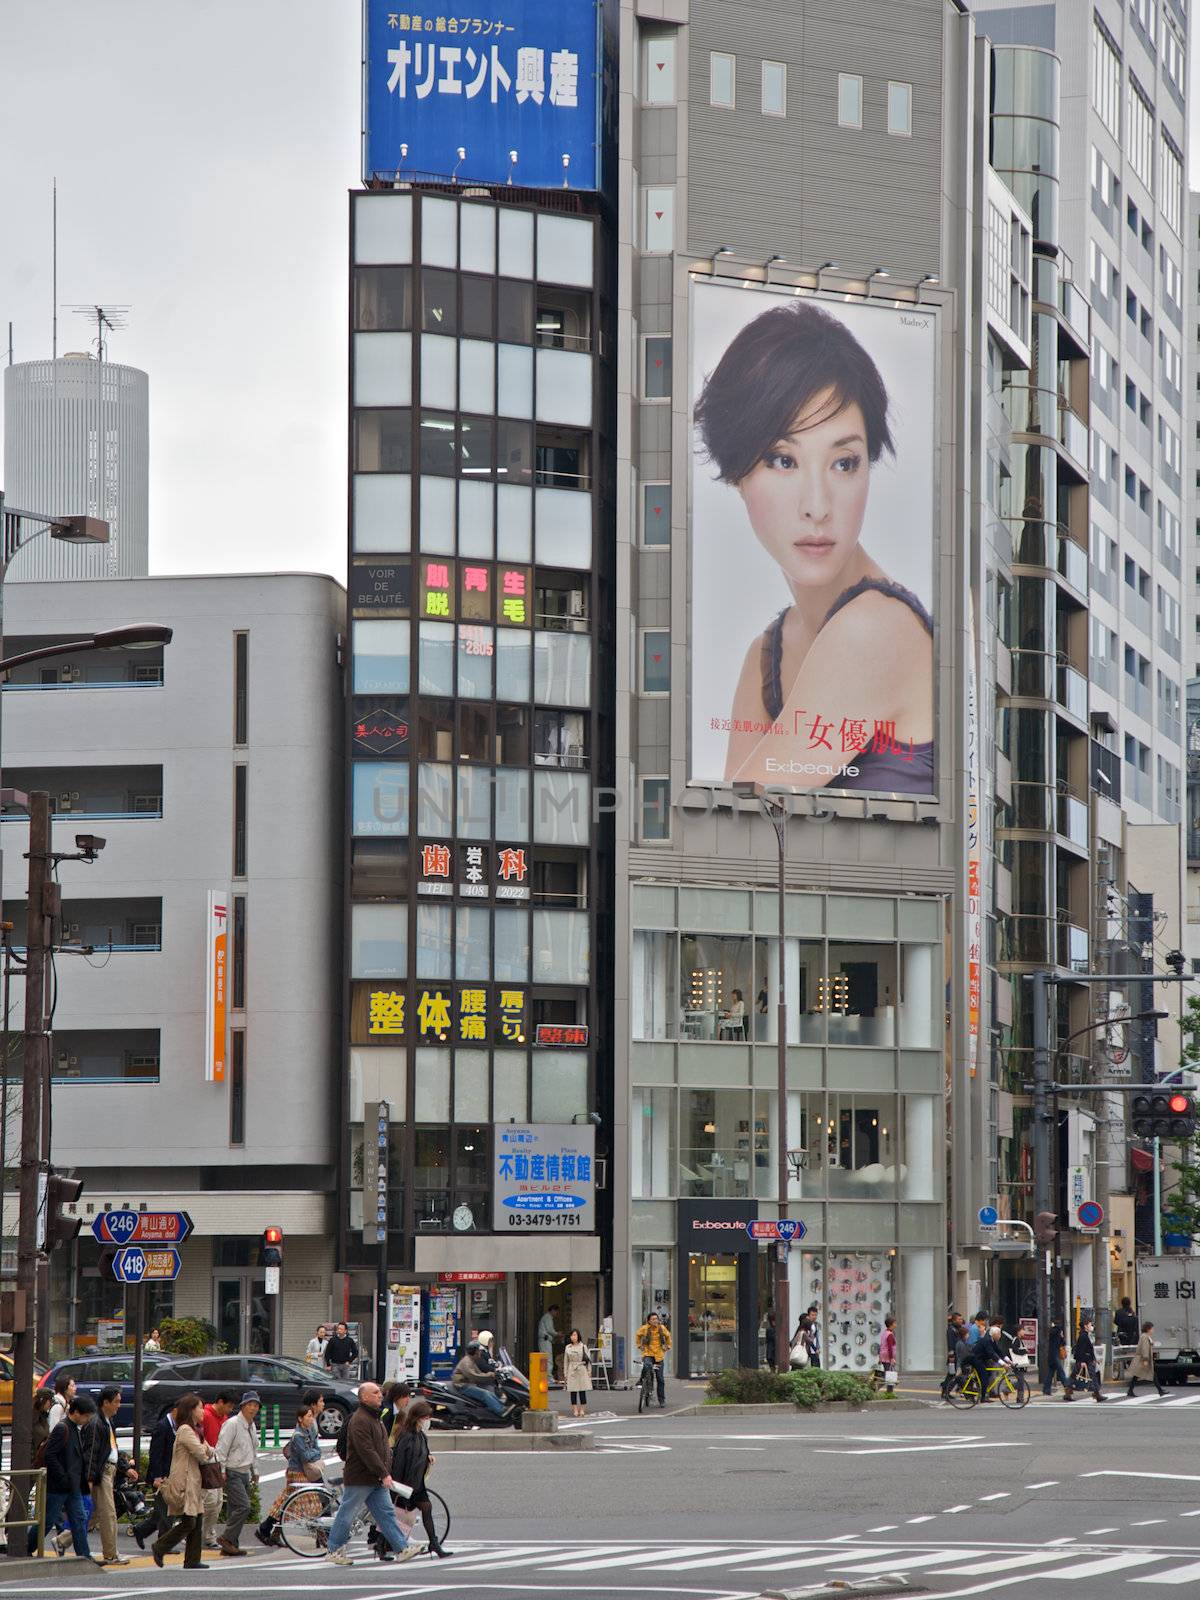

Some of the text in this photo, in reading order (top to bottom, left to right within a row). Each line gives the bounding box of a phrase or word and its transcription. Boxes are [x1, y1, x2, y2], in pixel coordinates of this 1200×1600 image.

[388, 14, 515, 36] 不動産の総合プランナー
[387, 40, 579, 107] オリエント興産
[368, 569, 395, 579] VOIR
[374, 582, 389, 591] DE
[355, 724, 409, 738] 美人公司
[765, 758, 860, 778] Ex:beaute
[422, 843, 528, 884] 歯 岩本 科
[427, 883, 525, 899] TEL 408 2022
[369, 989, 525, 1041] 整体 腰痛 肩こり
[498, 1154, 591, 1182] 不動産情報館
[110, 1215, 134, 1232] 246
[140, 1215, 176, 1231] 青山通り
[779, 1223, 795, 1233] 246
[124, 1256, 143, 1274] 418
[1154, 1281, 1170, 1299] 豊
